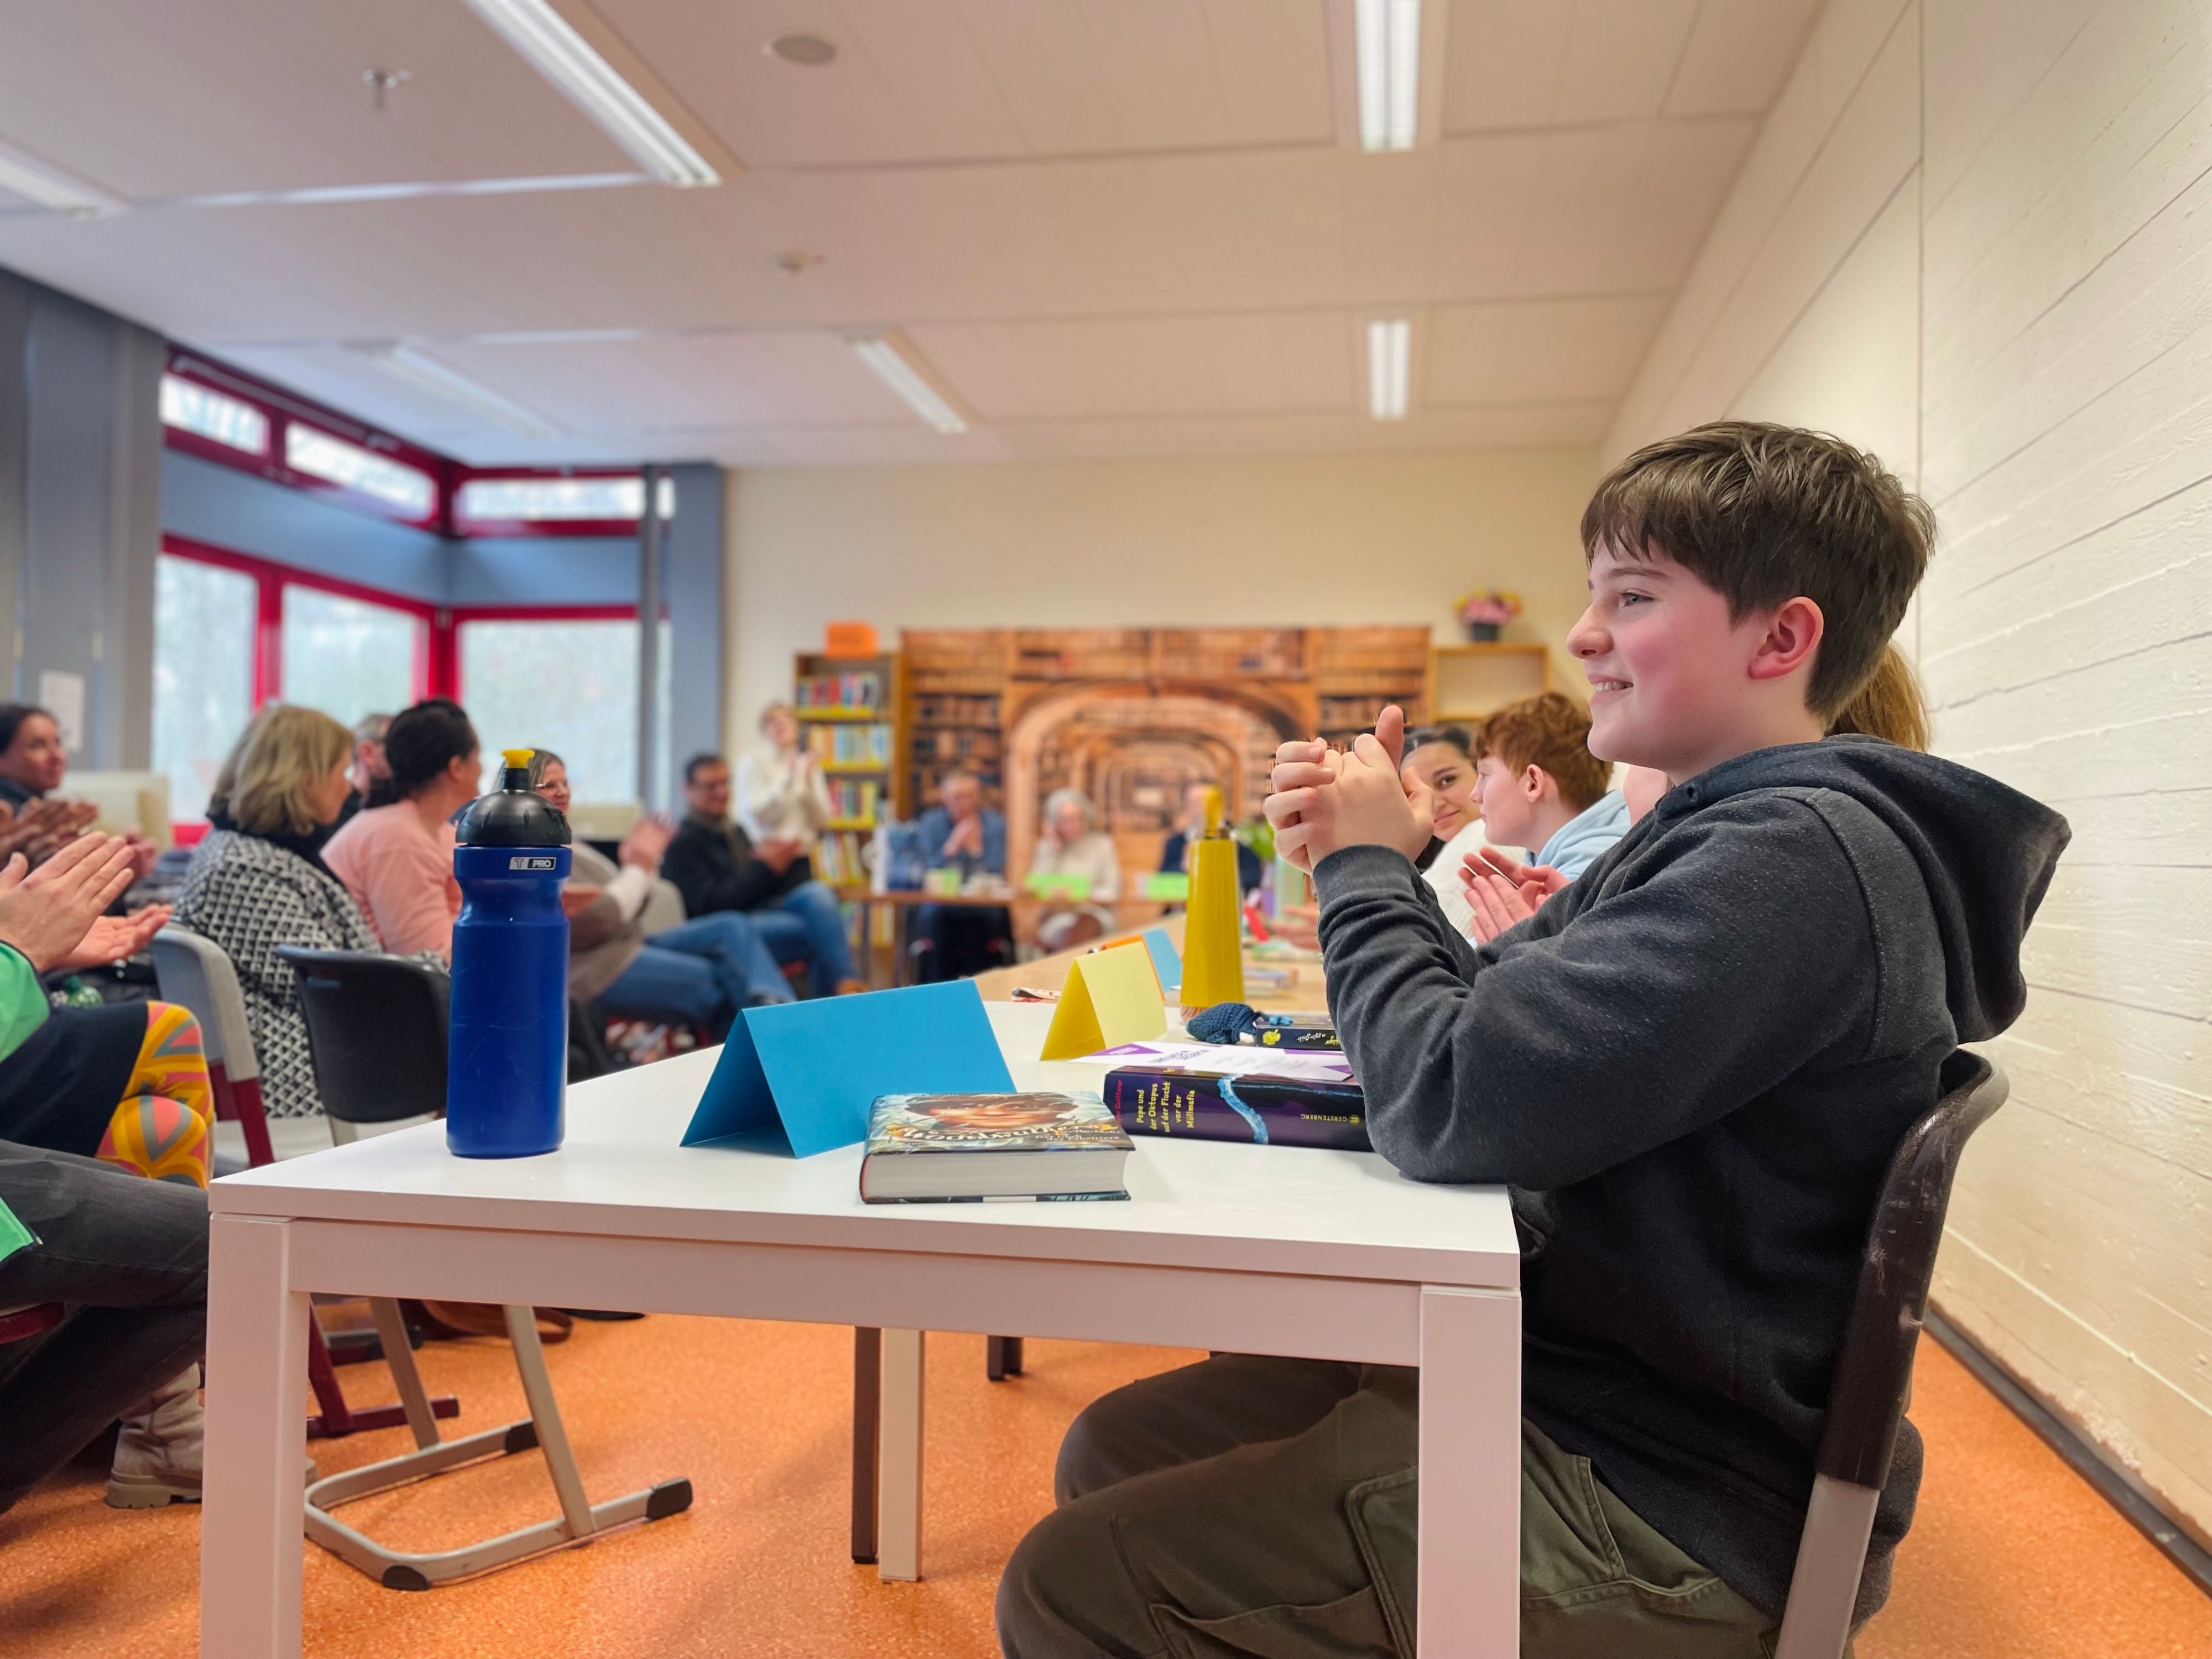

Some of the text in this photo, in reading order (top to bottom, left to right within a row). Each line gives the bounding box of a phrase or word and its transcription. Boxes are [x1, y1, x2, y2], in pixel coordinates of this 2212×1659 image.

[532, 859, 552, 868] PRO
[1115, 1079, 1123, 1109] Quitterer
[1161, 1081, 1171, 1107] Flucht
[1173, 1094, 1182, 1108] der
[1136, 1089, 1145, 1123] Pepe und
[1148, 1083, 1159, 1130] der Oktopus
[1161, 1108, 1169, 1121] der
[1186, 1090, 1195, 1128] Müllmafia
[1161, 1121, 1170, 1133] auf
[1300, 1114, 1348, 1122] GERSTENBERG
